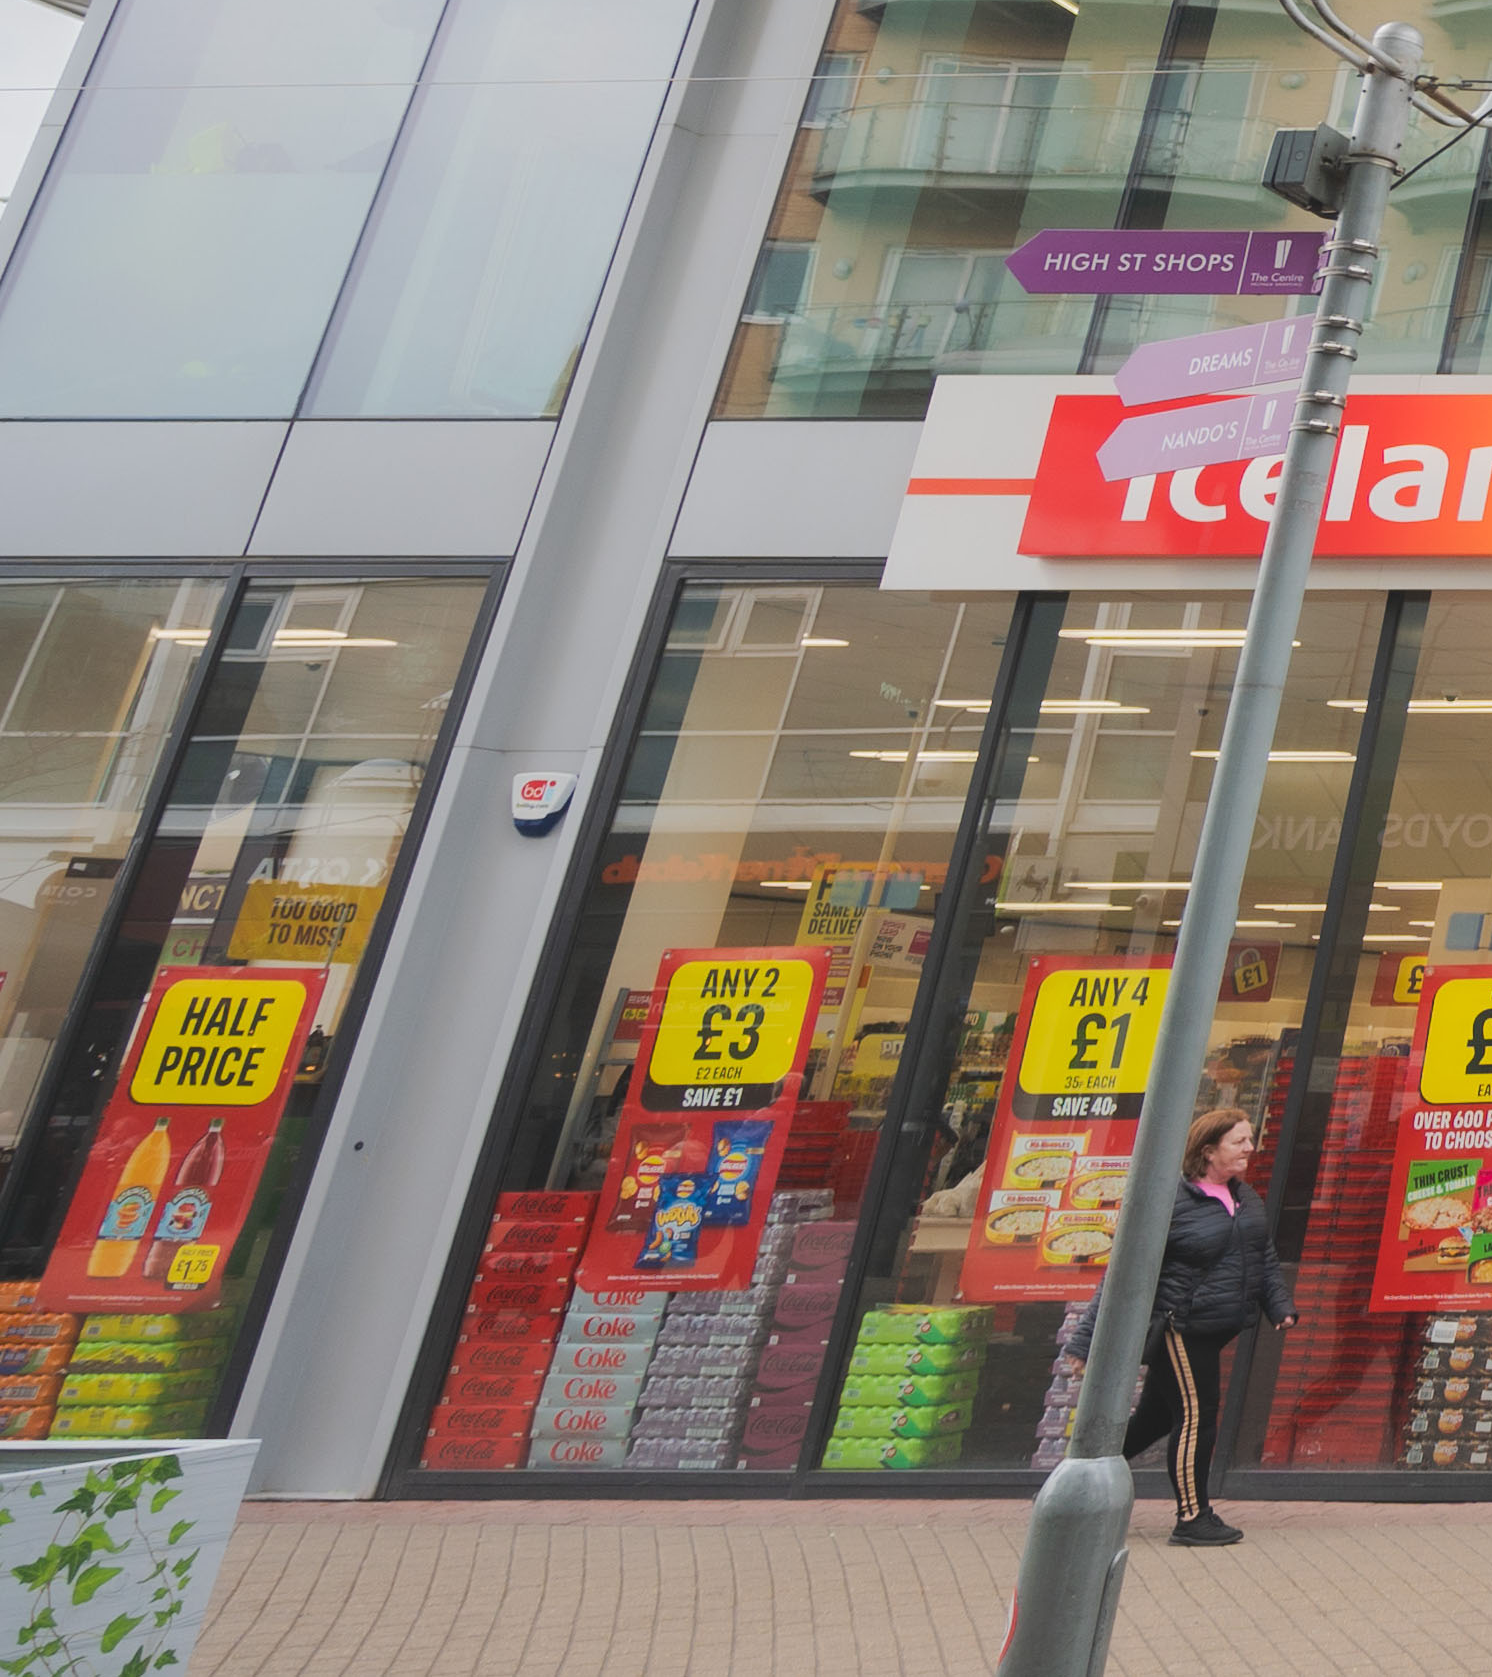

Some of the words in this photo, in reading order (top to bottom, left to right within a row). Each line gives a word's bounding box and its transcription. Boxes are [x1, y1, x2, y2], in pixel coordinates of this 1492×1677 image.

[1044, 253, 1109, 271] HIGH
[1118, 254, 1146, 271] ST
[1153, 254, 1234, 272] SHOPS
[1251, 273, 1269, 282] The
[1271, 273, 1304, 282] Centre
[1189, 348, 1253, 374] DREAMS
[1162, 421, 1238, 451] NANDO'S
[272, 899, 306, 920] TOO
[310, 902, 358, 923] GOOD
[269, 923, 291, 945] TO
[293, 925, 348, 947] MISS!
[701, 969, 759, 998] ANY
[762, 968, 780, 997] 2
[1242, 964, 1263, 988] £1
[1069, 977, 1128, 1007] ANY
[1131, 977, 1150, 1007] 4
[179, 998, 275, 1036] HALF
[693, 1004, 765, 1060] £3
[1068, 1013, 1132, 1070] £1
[153, 1046, 265, 1088] PRICE
[696, 1067, 711, 1080] £2
[713, 1067, 743, 1080] EACH
[1087, 1075, 1116, 1088] EACH
[682, 1088, 722, 1107] SAVE
[723, 1087, 743, 1107] £1
[1052, 1096, 1090, 1116] SAVE
[1091, 1096, 1118, 1116] 40p
[1413, 1110, 1451, 1130] OVER
[1453, 1110, 1484, 1129] 600
[1424, 1131, 1442, 1150] TO
[1414, 1175, 1436, 1189] THIN
[1438, 1164, 1469, 1182] CRUST
[583, 1317, 636, 1338] Coke
[574, 1347, 626, 1368] Coke
[564, 1378, 617, 1399] Coke
[554, 1409, 607, 1430] Coke
[551, 1440, 603, 1461] Coke
